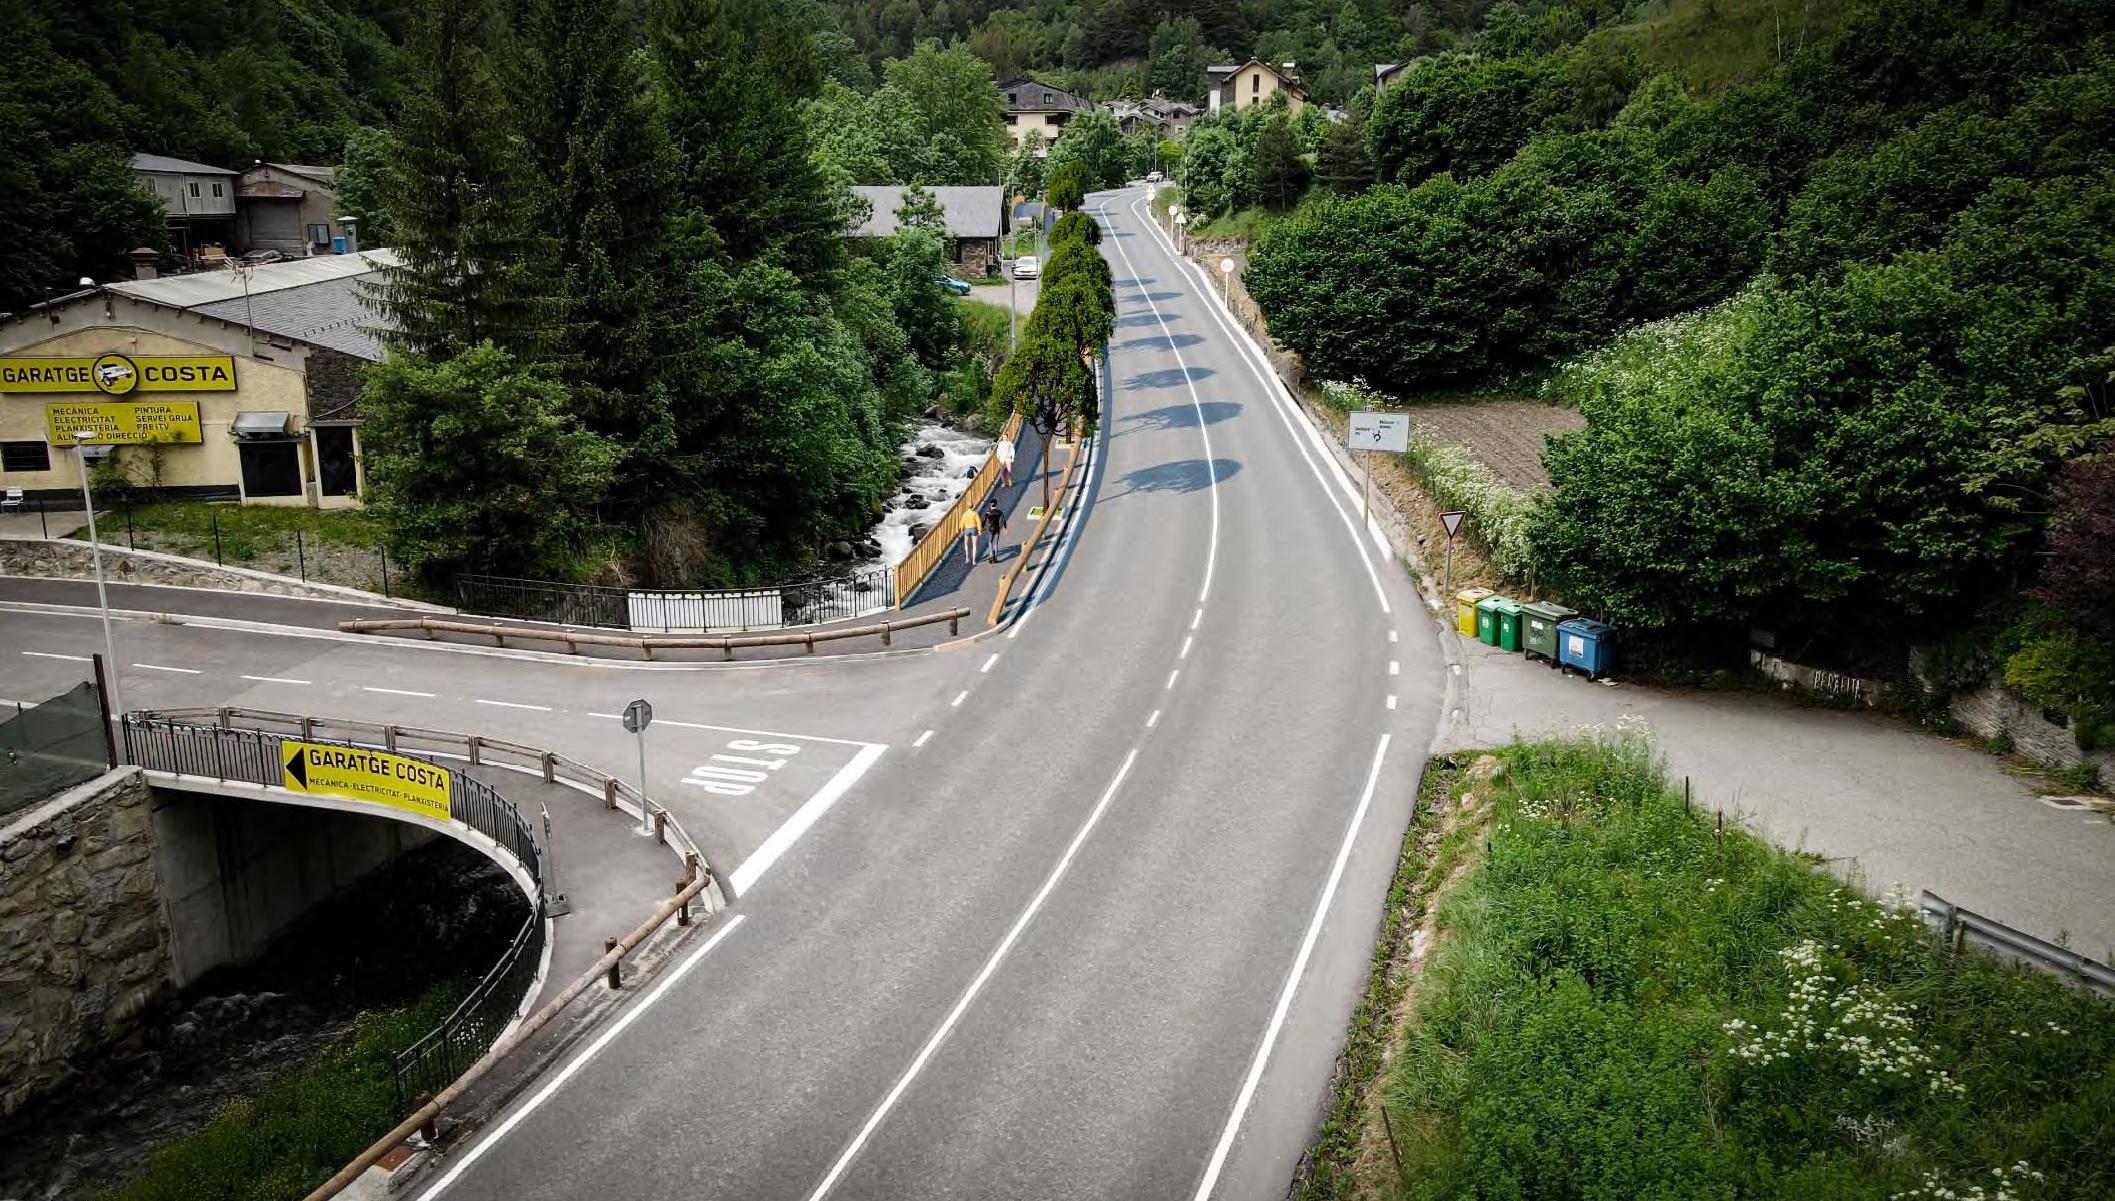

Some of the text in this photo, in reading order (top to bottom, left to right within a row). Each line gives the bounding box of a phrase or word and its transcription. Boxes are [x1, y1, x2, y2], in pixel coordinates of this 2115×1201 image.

[3, 366, 229, 382] GARATGE COSTA
[134, 406, 171, 414] PINTURA
[54, 415, 115, 424] ELECTRICITAT
[135, 414, 193, 423] SERVEI GRUA
[55, 424, 119, 432] PLANXISTERIA
[136, 423, 154, 431] PRE
[309, 749, 445, 791] GARATGE COSTA
[680, 739, 801, 796] STOP
